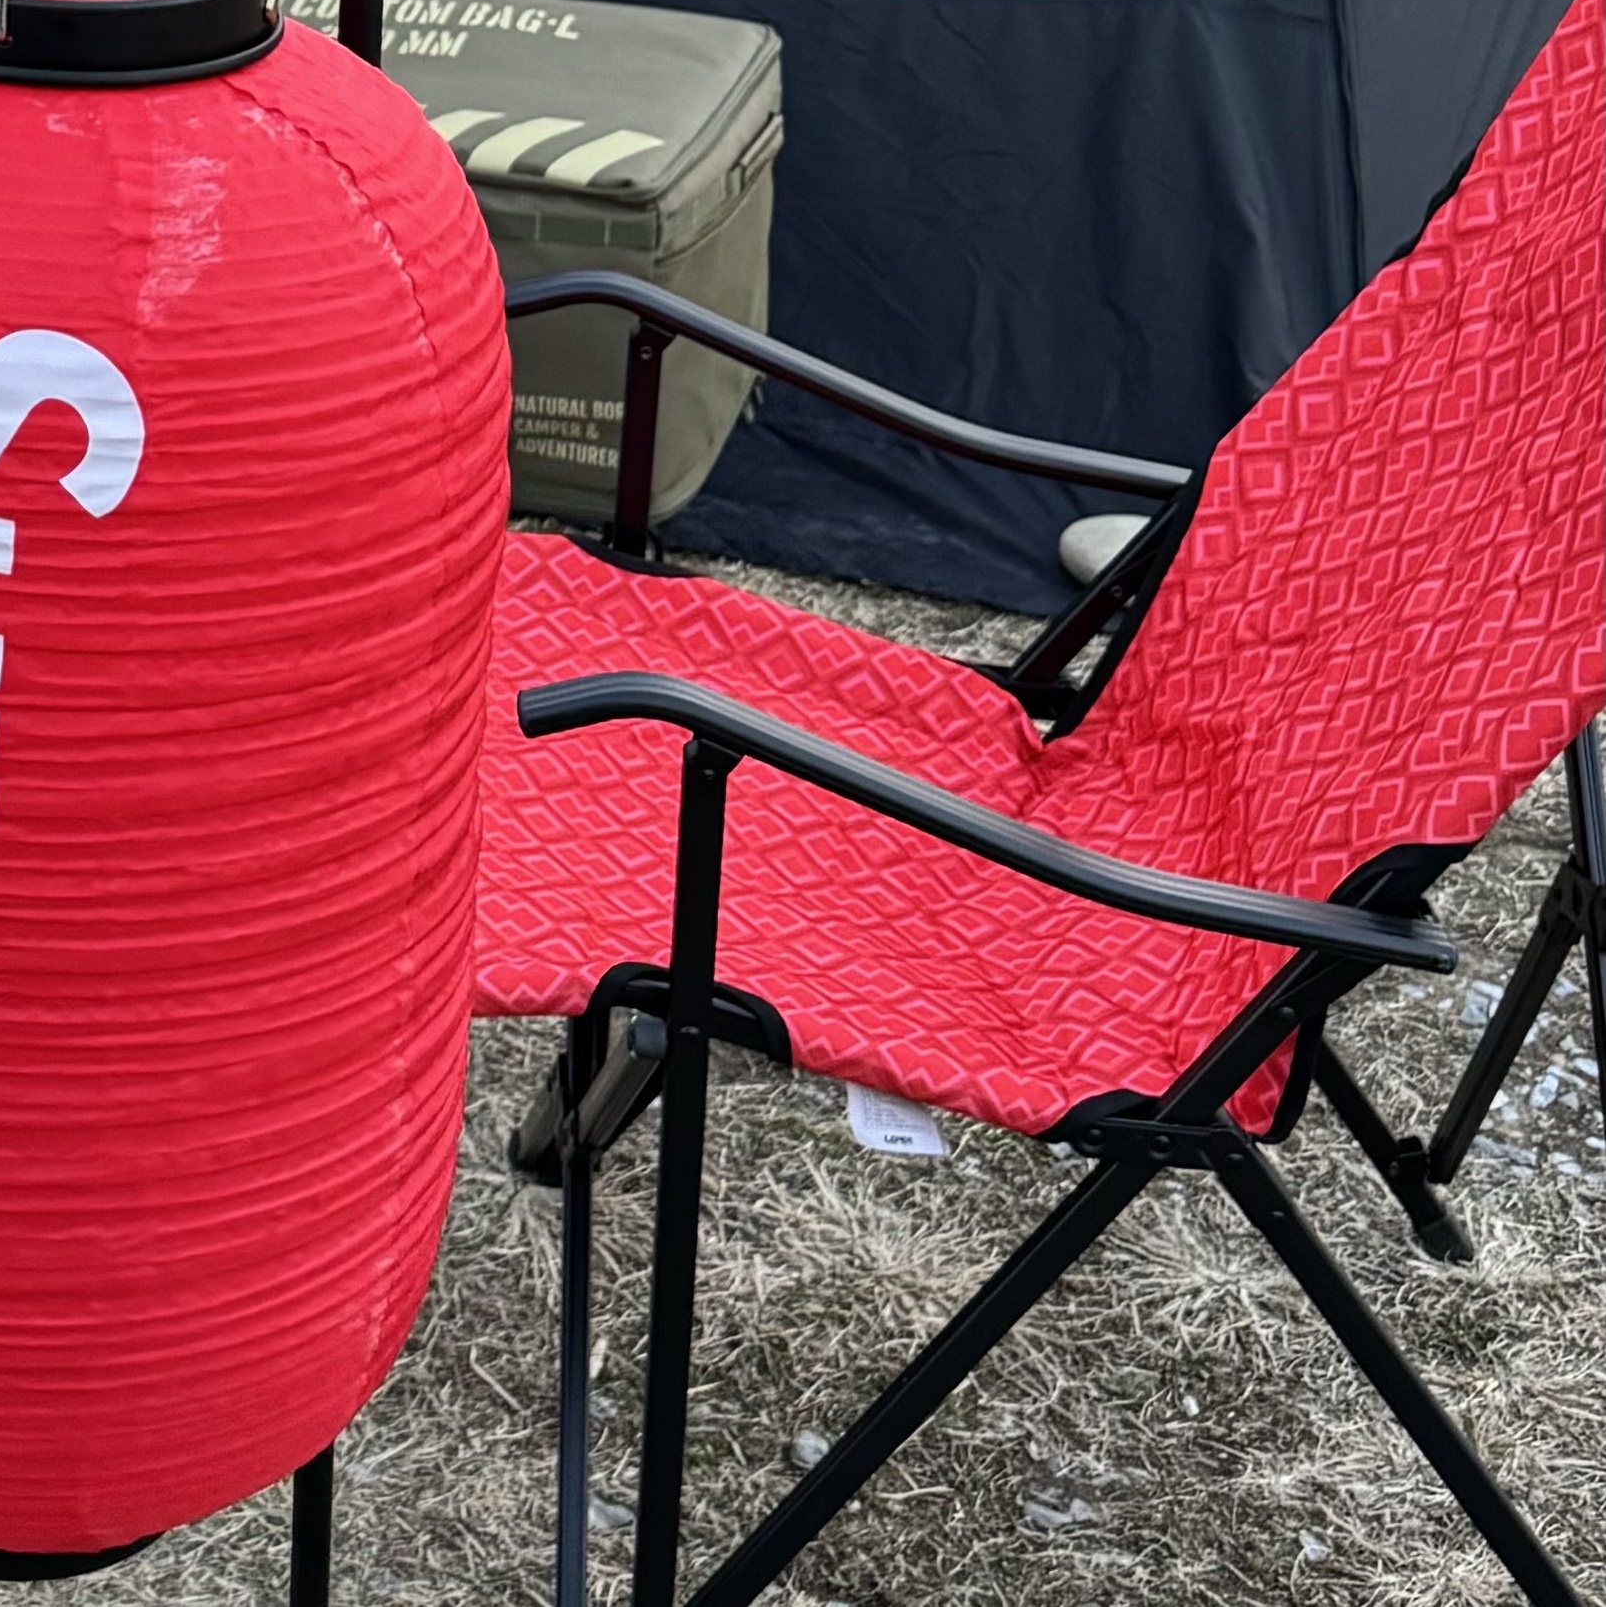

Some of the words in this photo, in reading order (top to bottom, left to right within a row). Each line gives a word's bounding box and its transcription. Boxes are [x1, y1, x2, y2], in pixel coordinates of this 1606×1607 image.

[398, 29, 468, 57] MM
[515, 395, 588, 419] NATURAL
[593, 400, 625, 422] BOR
[514, 418, 582, 438] CAMPER
[515, 436, 620, 468] ADVENTURER
